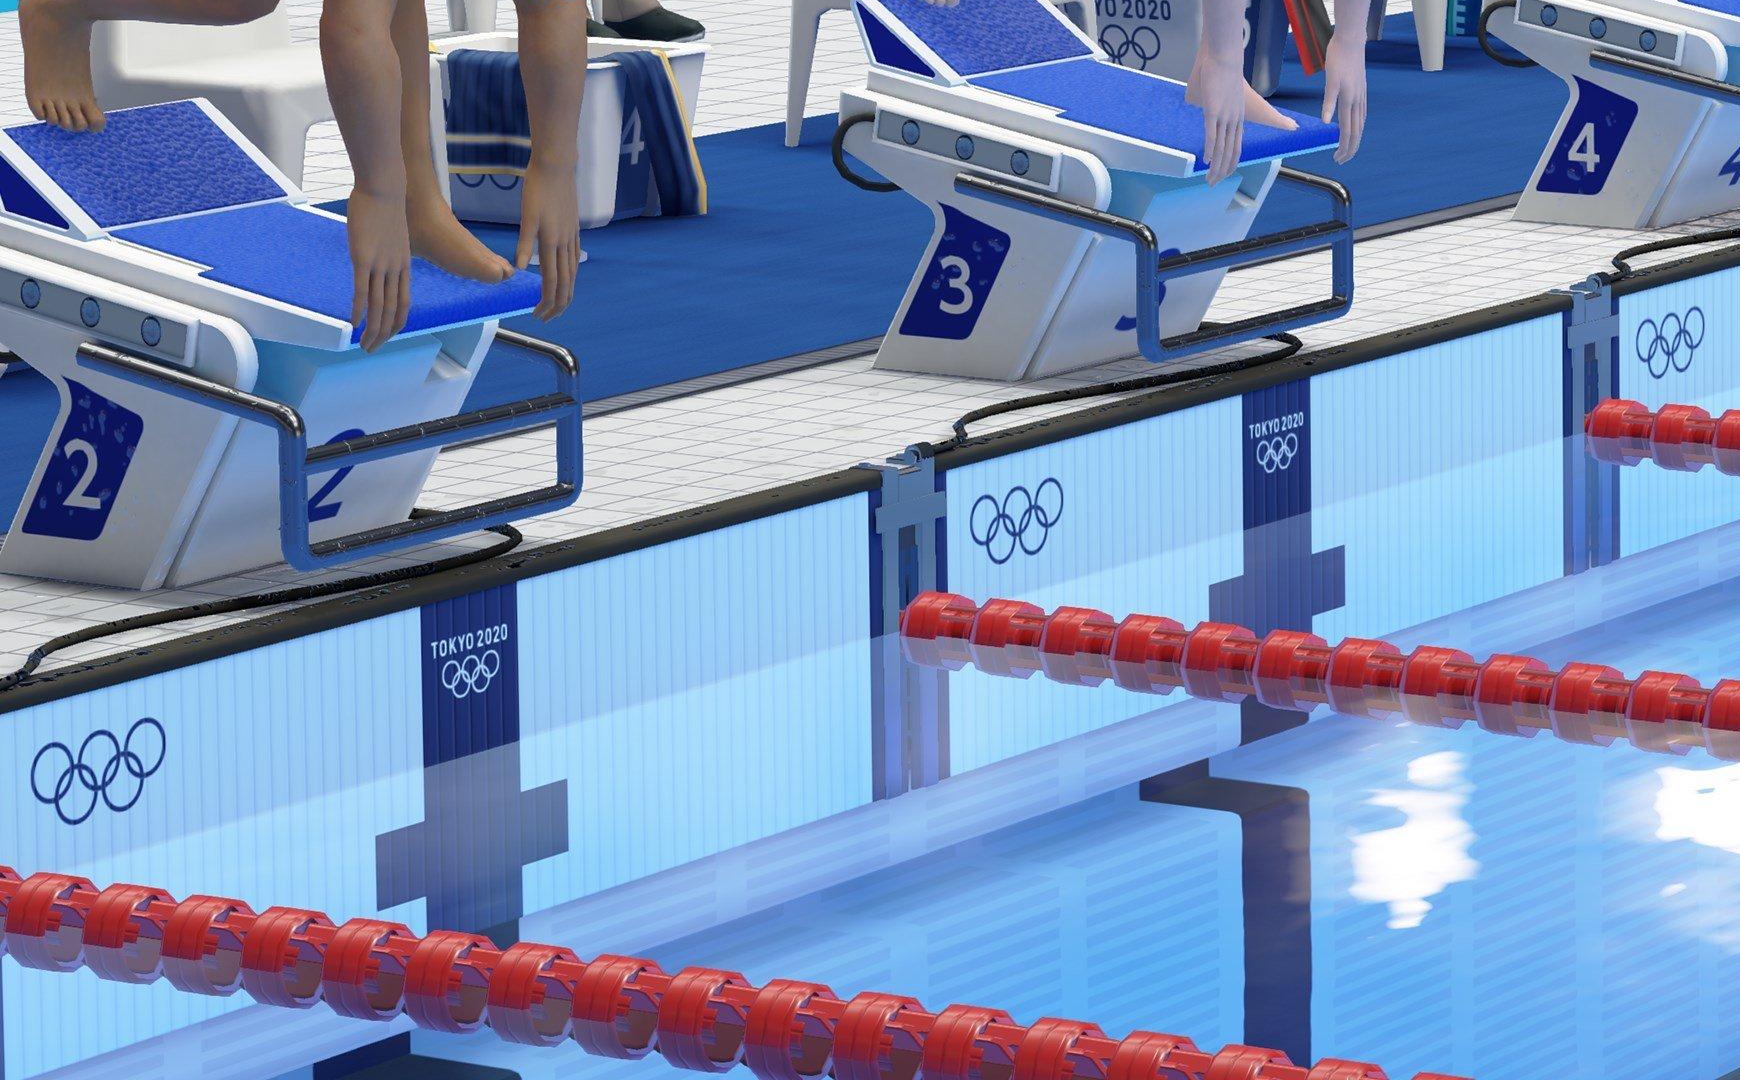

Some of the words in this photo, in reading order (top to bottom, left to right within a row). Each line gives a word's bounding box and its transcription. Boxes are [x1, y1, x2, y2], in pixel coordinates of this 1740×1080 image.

[619, 106, 645, 165] 4
[1568, 122, 1600, 173] 4
[939, 255, 974, 315] 3
[1248, 418, 1280, 439] TOKYO
[1281, 411, 1304, 432] 2020
[62, 438, 101, 510] 2
[430, 632, 474, 659] TOKYO
[476, 623, 508, 648] 2020
